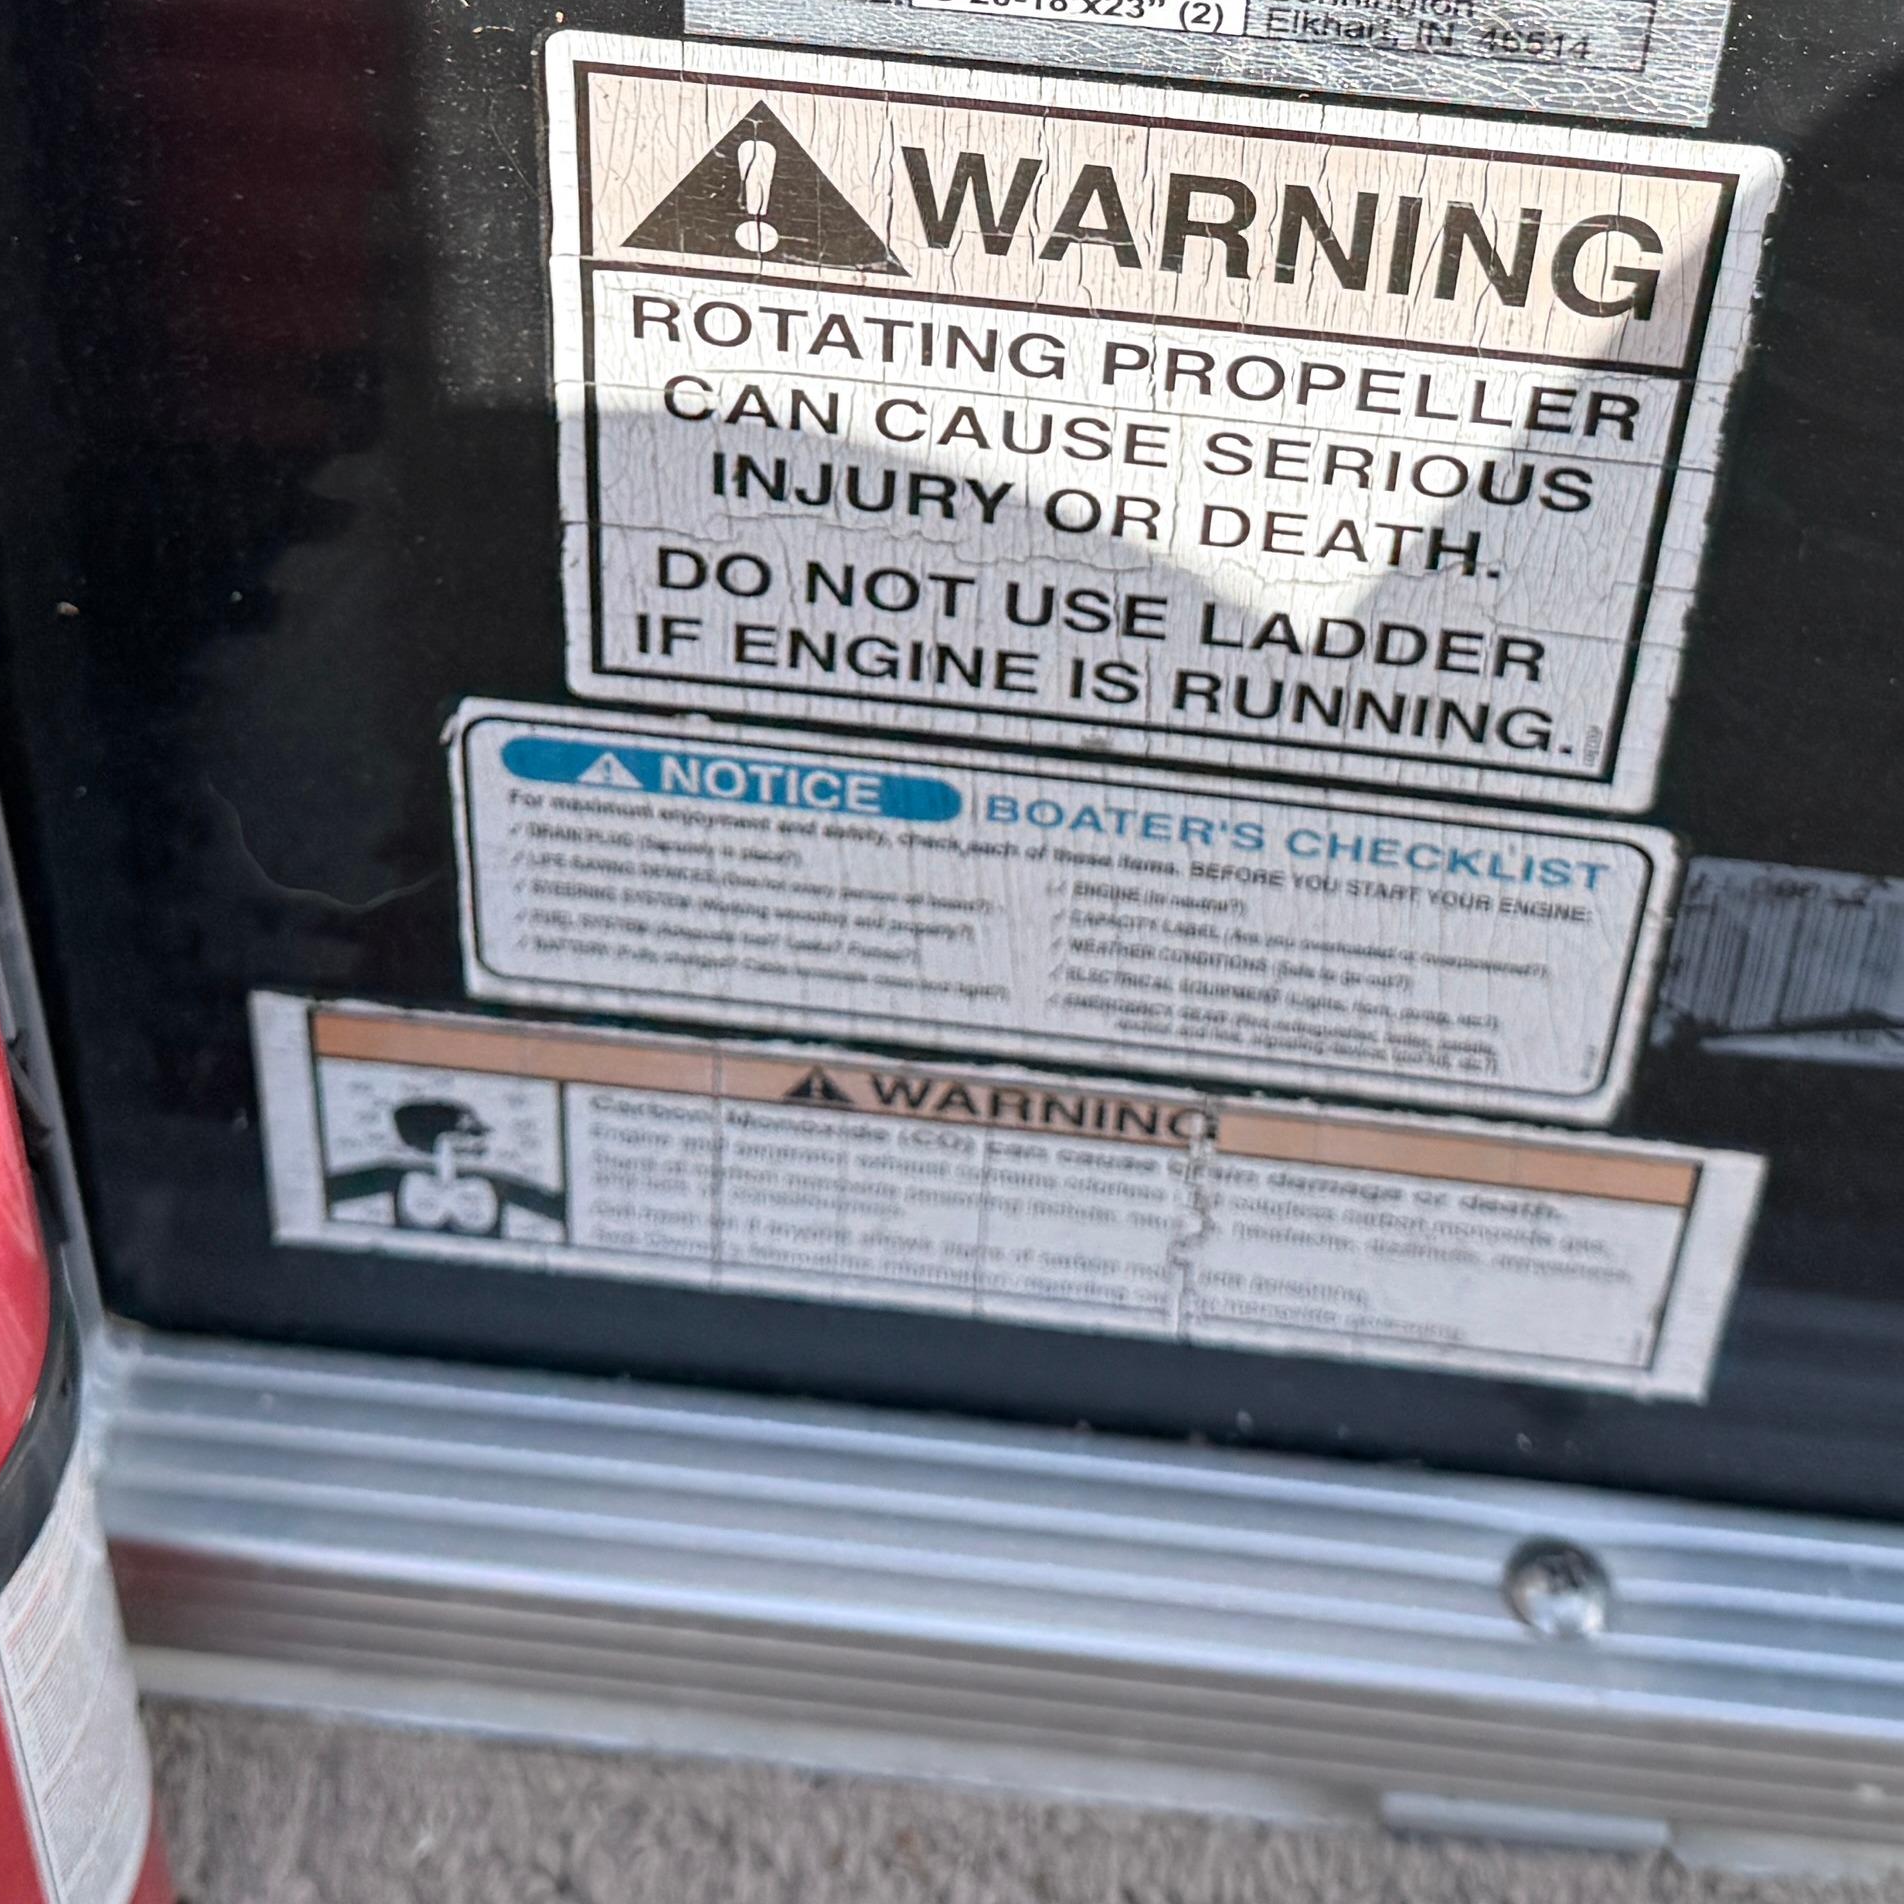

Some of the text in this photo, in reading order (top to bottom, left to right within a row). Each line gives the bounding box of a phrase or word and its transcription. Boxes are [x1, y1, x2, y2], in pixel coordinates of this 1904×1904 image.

[1178, 0, 1225, 34] (2)
[1415, 19, 1457, 48] IN
[901, 144, 1665, 324] WARNING
[630, 295, 1641, 442] ROTATING PROPELLER
[663, 374, 1595, 513] CAN CAUSE SERIOUS
[712, 452, 1500, 580] INJURY OR DEATH.
[656, 546, 1547, 683] DO NOT USE LADDER
[636, 613, 705, 657] IF
[733, 624, 1041, 695] ENGINE
[1069, 657, 1142, 705] IS
[1172, 669, 1574, 755] RUNNING.
[509, 787, 543, 807] For
[1189, 860, 1286, 888] BEFORE
[1291, 872, 1339, 893] YOU
[1346, 877, 1420, 903] START
[1427, 888, 1492, 912] YOUR
[1498, 896, 1594, 923] ENGINE:
[658, 754, 1610, 892] NOTICE BOATER'S CHECKLIST
[869, 1070, 1221, 1141] WARNING
